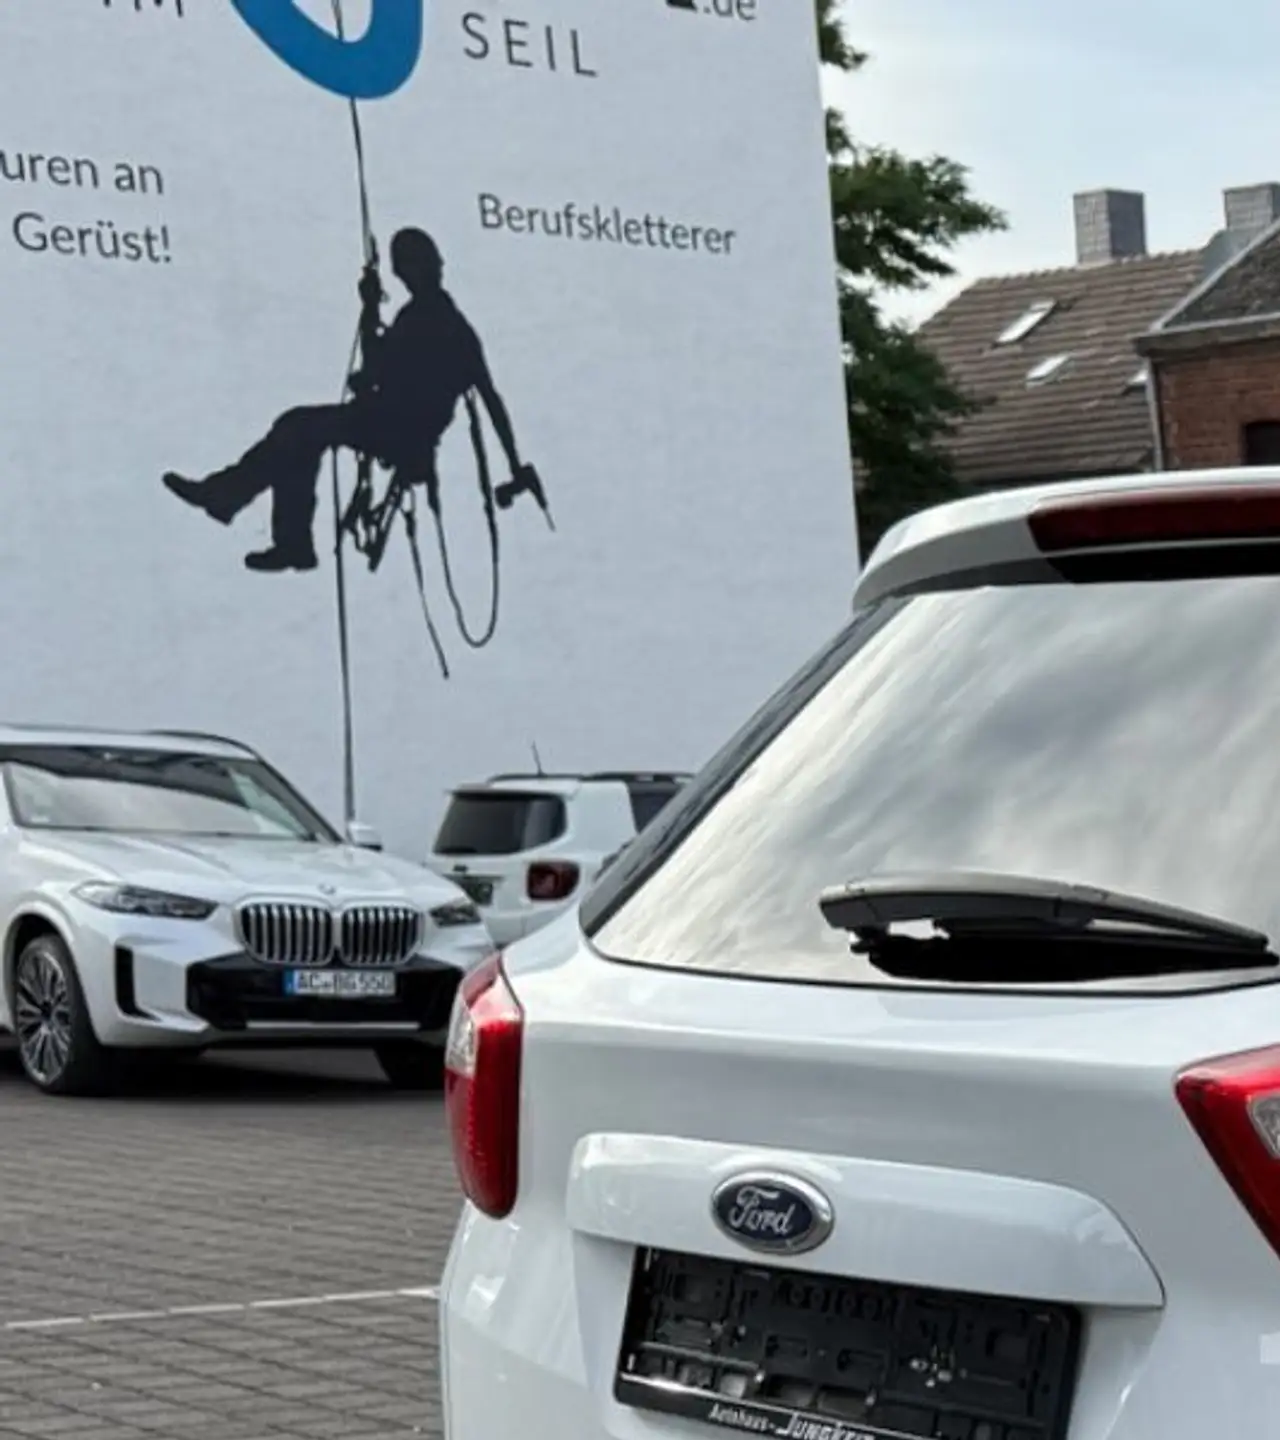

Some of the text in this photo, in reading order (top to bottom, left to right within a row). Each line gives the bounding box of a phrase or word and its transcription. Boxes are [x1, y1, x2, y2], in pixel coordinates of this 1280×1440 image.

[461, 12, 597, 77] SEIL
[114, 163, 163, 195] an
[13, 211, 171, 264] Gerüst!
[478, 193, 736, 254] Berufskletterer
[729, 1186, 797, 1236] Ford
